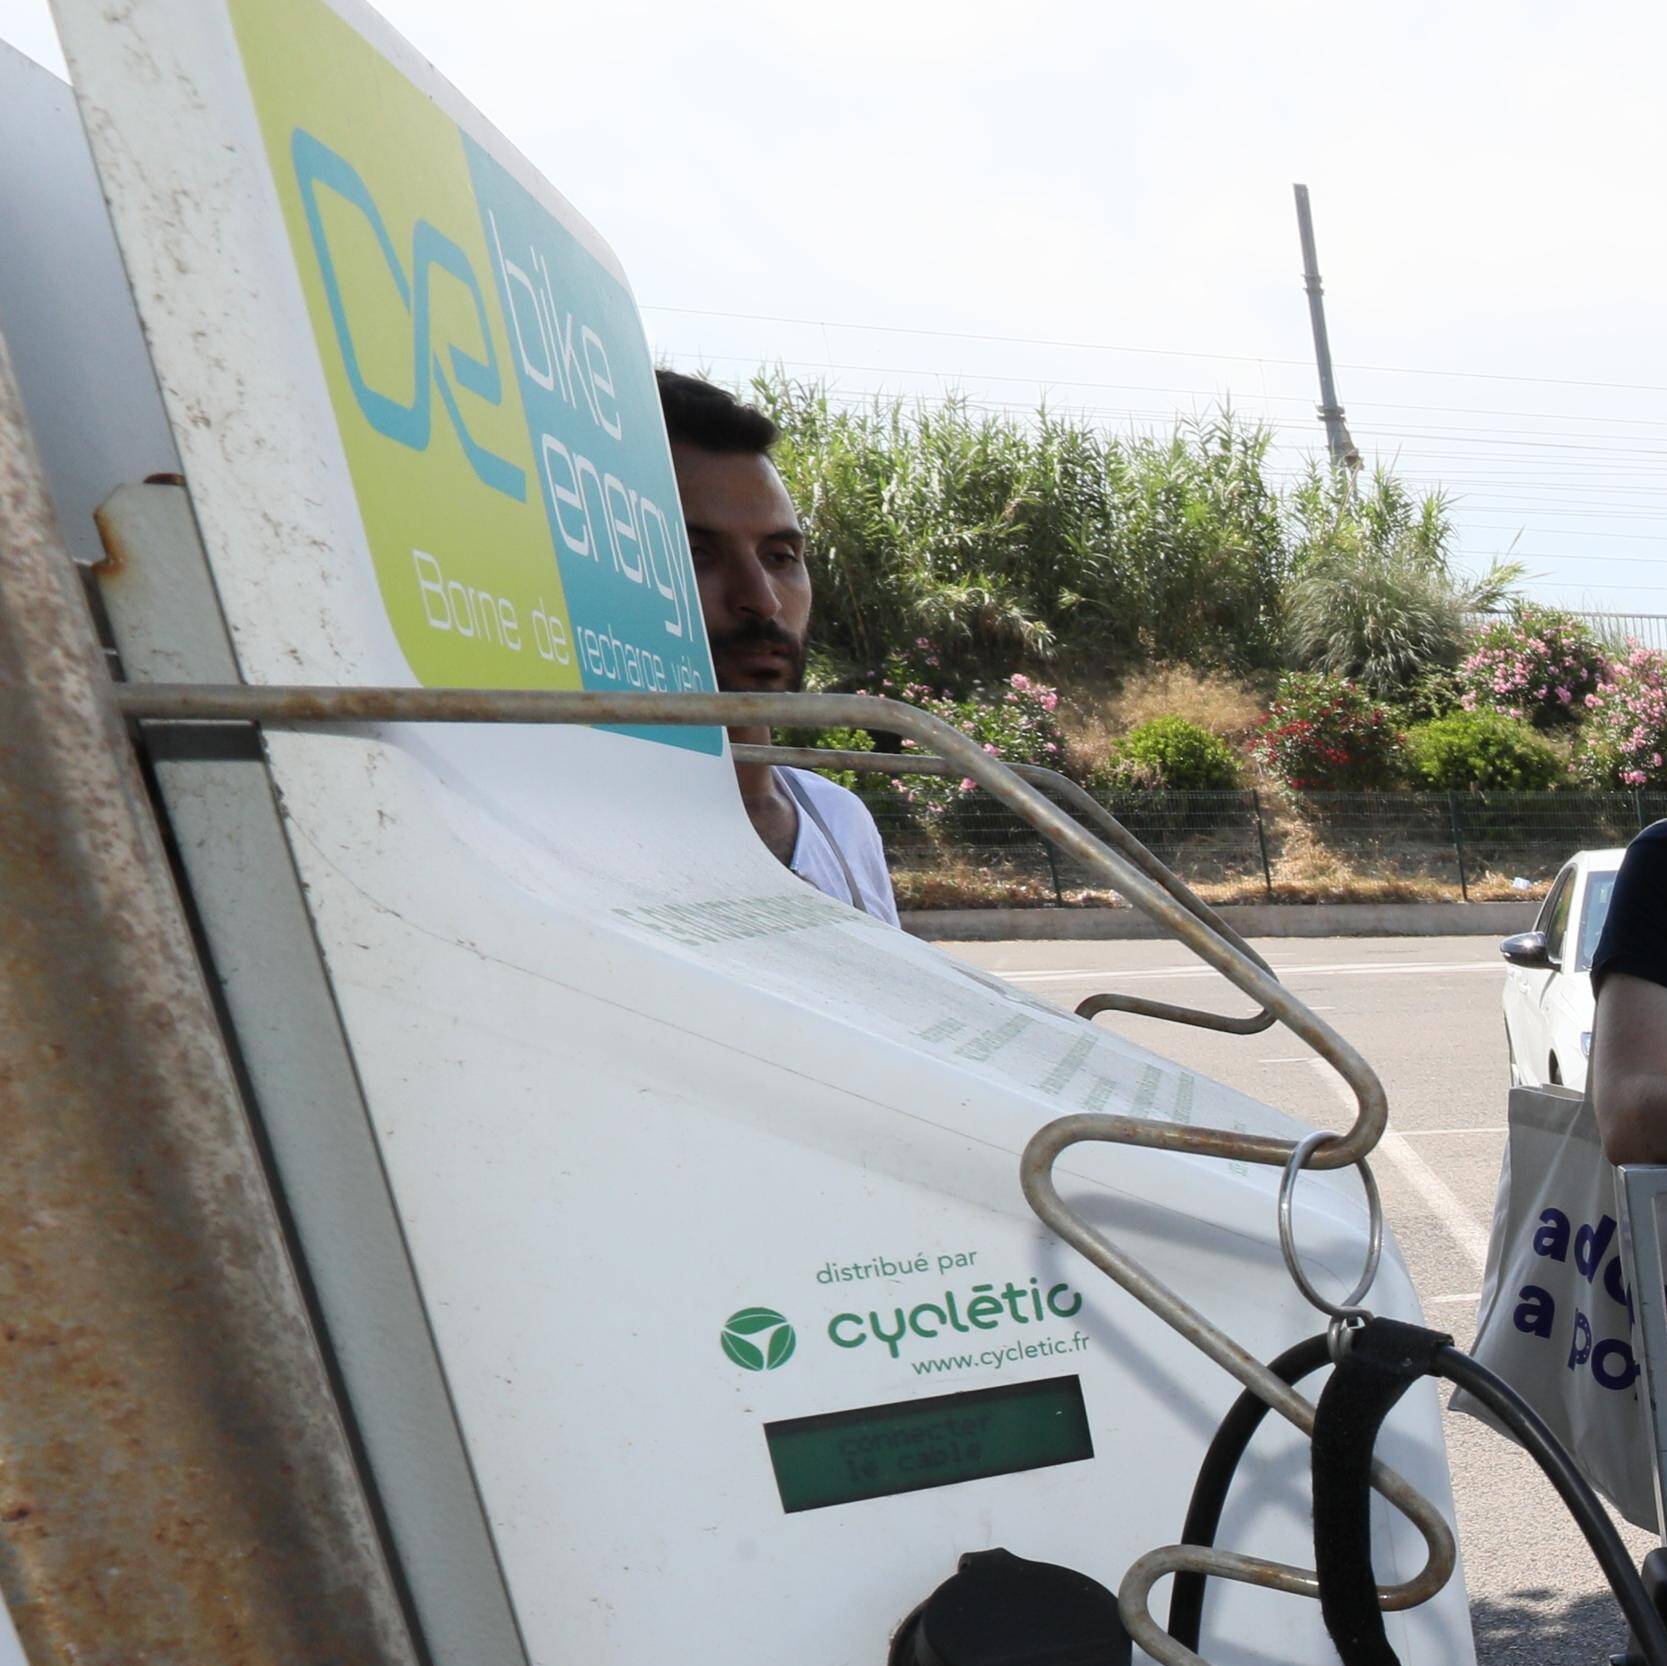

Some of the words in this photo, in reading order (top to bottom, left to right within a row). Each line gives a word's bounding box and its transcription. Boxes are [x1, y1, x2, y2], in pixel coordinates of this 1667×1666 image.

[489, 211, 622, 440] bike
[542, 431, 694, 642] energy
[413, 549, 521, 651] Borne
[531, 598, 570, 665] de
[816, 1251, 930, 1285] distribué
[937, 1250, 978, 1275] par
[912, 1330, 1091, 1376] www.cycletic.fr
[1513, 1285, 1555, 1339] a
[1567, 1307, 1641, 1391] po
